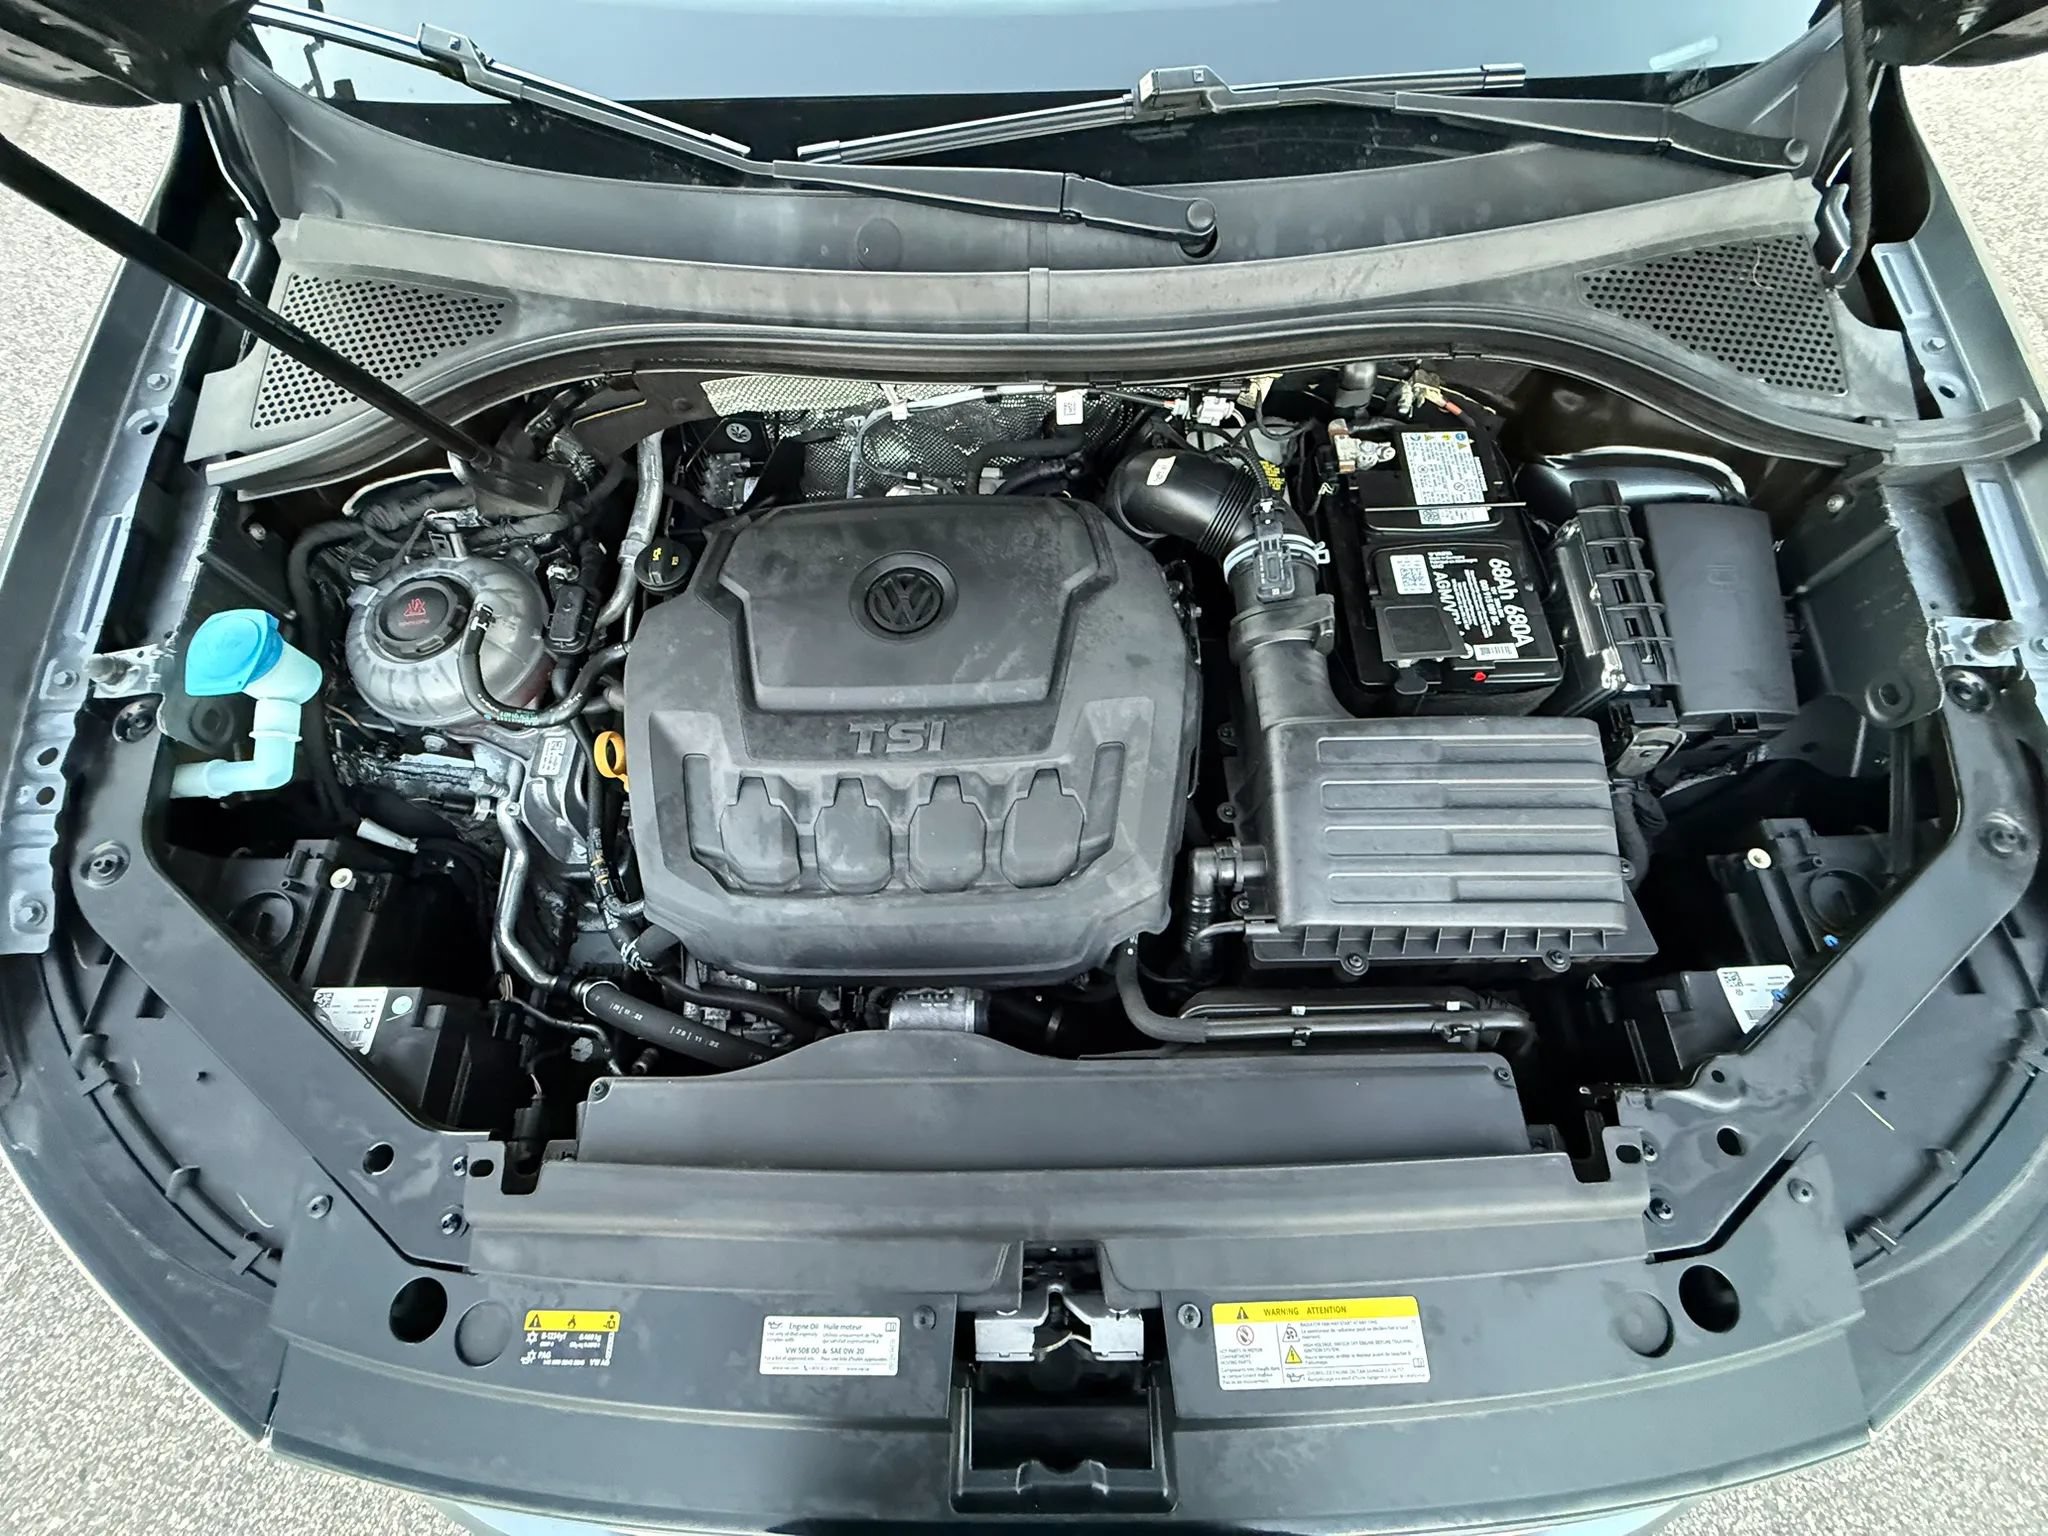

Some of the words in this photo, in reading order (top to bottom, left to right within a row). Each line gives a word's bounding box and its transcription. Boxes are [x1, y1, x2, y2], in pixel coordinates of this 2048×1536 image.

[1488, 557, 1519, 600] 68Ah
[1503, 604, 1535, 647] 680A
[849, 721, 947, 753] TSI
[789, 1323, 809, 1331] Engine
[1263, 1307, 1299, 1316] WARNING
[1307, 1306, 1347, 1315] ATTENTION
